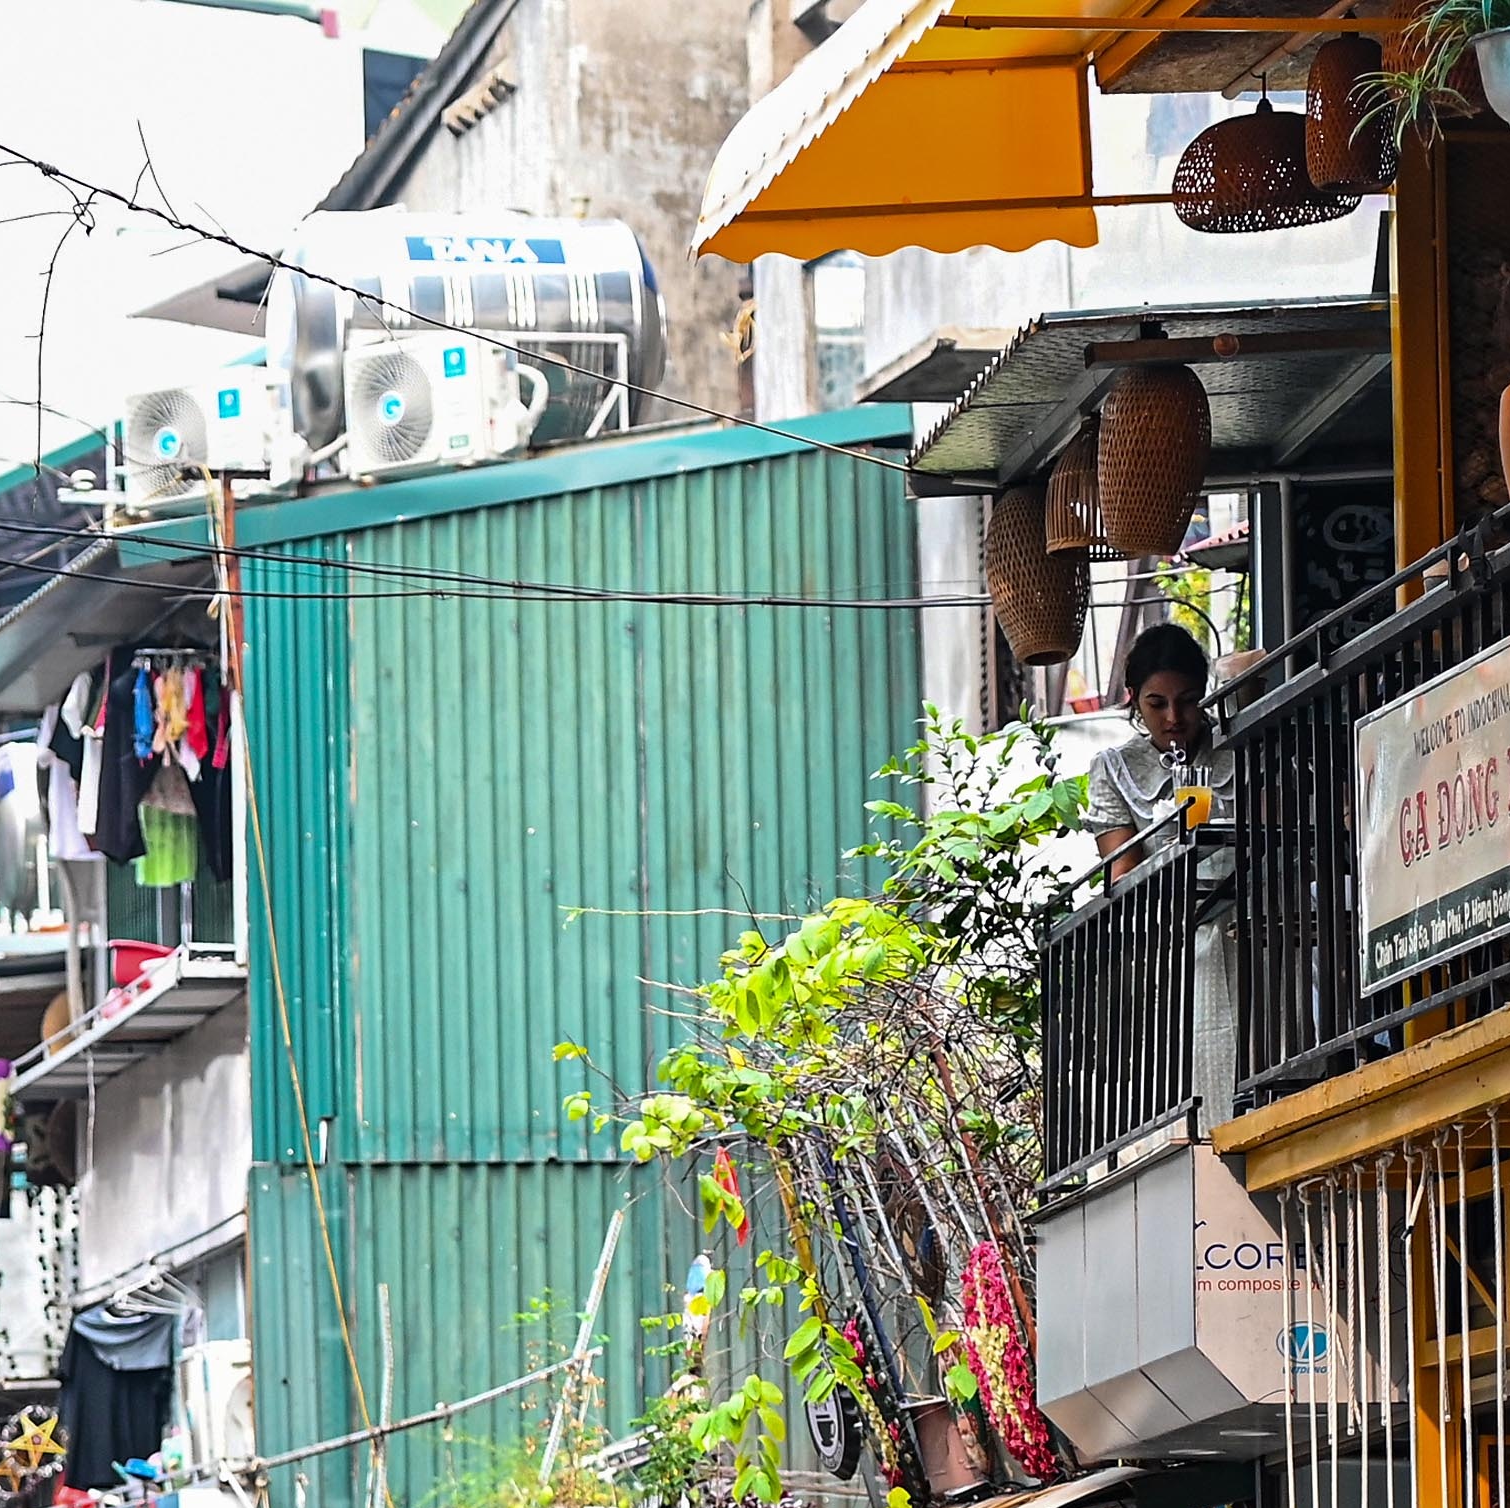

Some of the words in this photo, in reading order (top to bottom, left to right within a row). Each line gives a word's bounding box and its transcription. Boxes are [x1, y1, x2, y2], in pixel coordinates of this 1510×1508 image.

[1413, 714, 1453, 757] WELCOME
[1455, 708, 1466, 739] TO
[1399, 791, 1431, 867] GA
